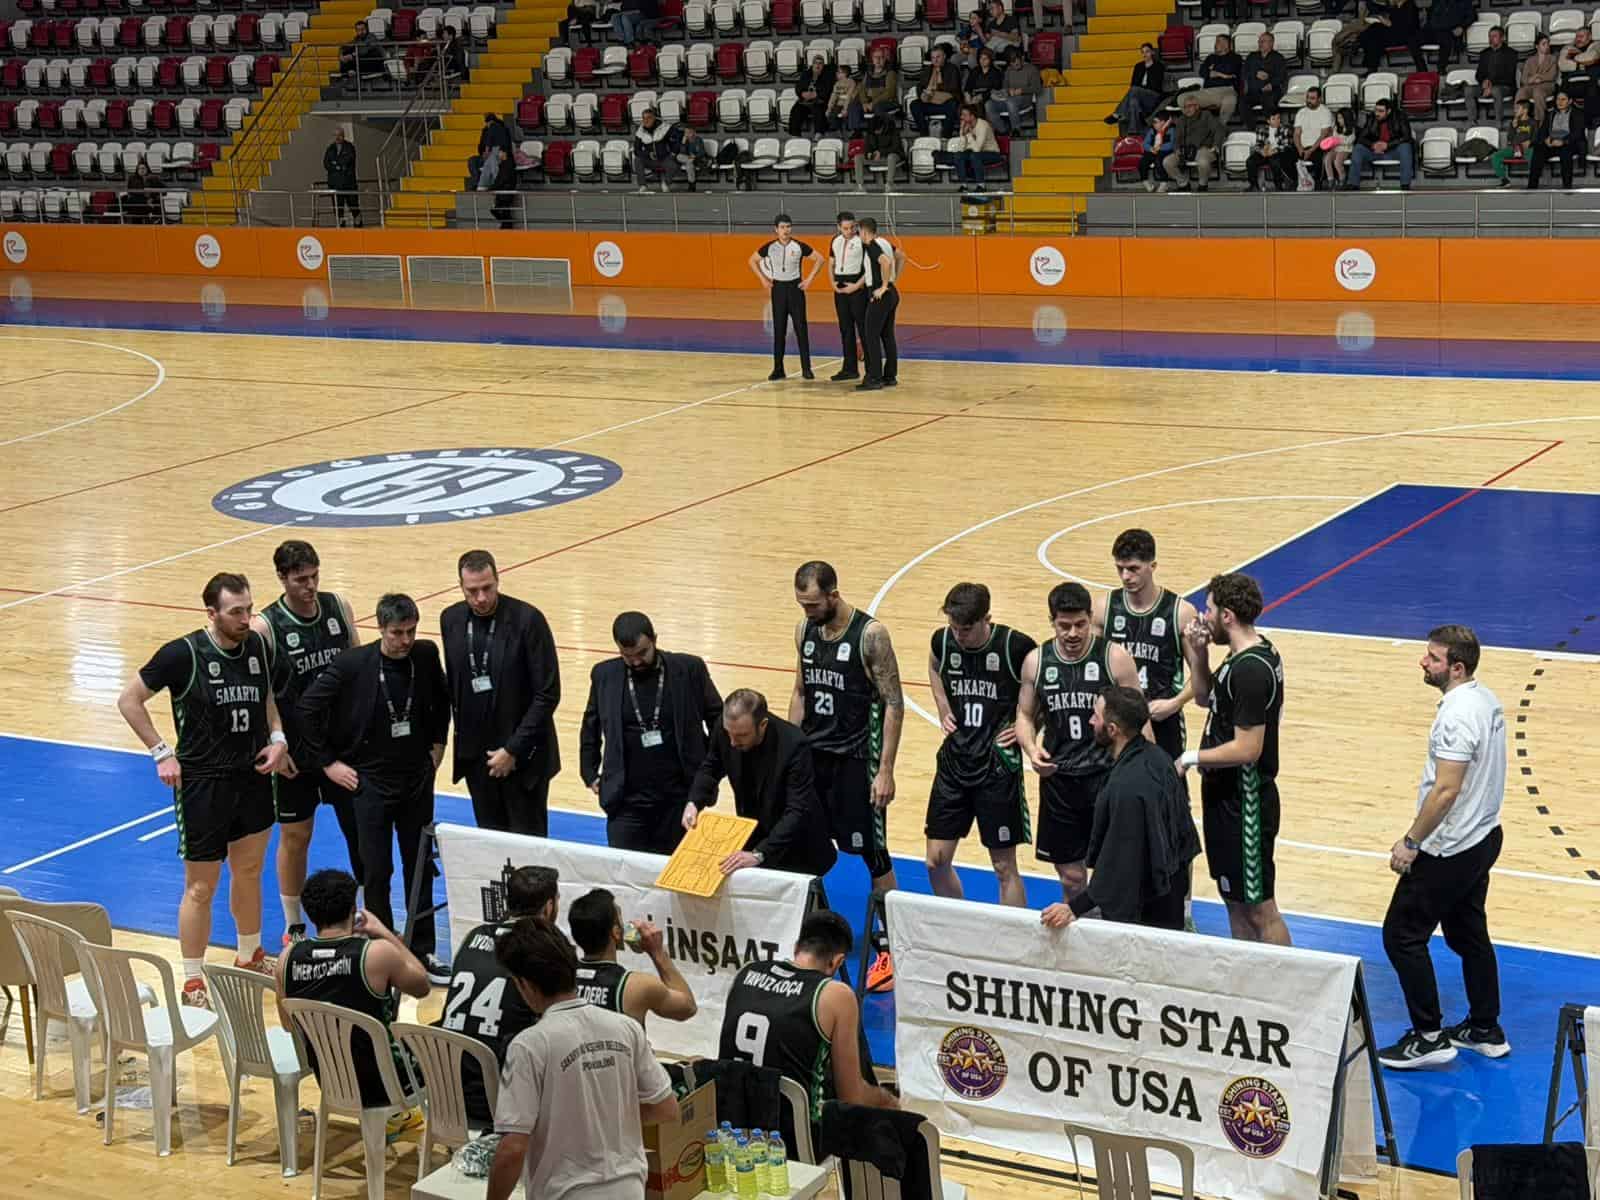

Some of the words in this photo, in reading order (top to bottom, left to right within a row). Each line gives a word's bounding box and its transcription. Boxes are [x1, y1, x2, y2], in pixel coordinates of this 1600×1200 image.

[1120, 641, 1160, 663] KARYA
[805, 668, 846, 691] SAKARYA
[950, 680, 998, 700] SAKARYA
[216, 686, 260, 705] SAKARYA
[814, 690, 834, 716] 23
[231, 708, 250, 732] 13
[964, 702, 983, 727] 10
[1068, 715, 1082, 740] 8
[666, 917, 780, 975] İNŞAAT
[441, 971, 507, 1037] 24
[946, 971, 1143, 1041] SHINING
[1160, 1005, 1292, 1068] STAR
[734, 1011, 770, 1068] 9
[1028, 1051, 1093, 1098] OF
[1108, 1064, 1202, 1122] USA
[1225, 1080, 1260, 1100] SHINING
[1262, 1082, 1286, 1114] STARS
